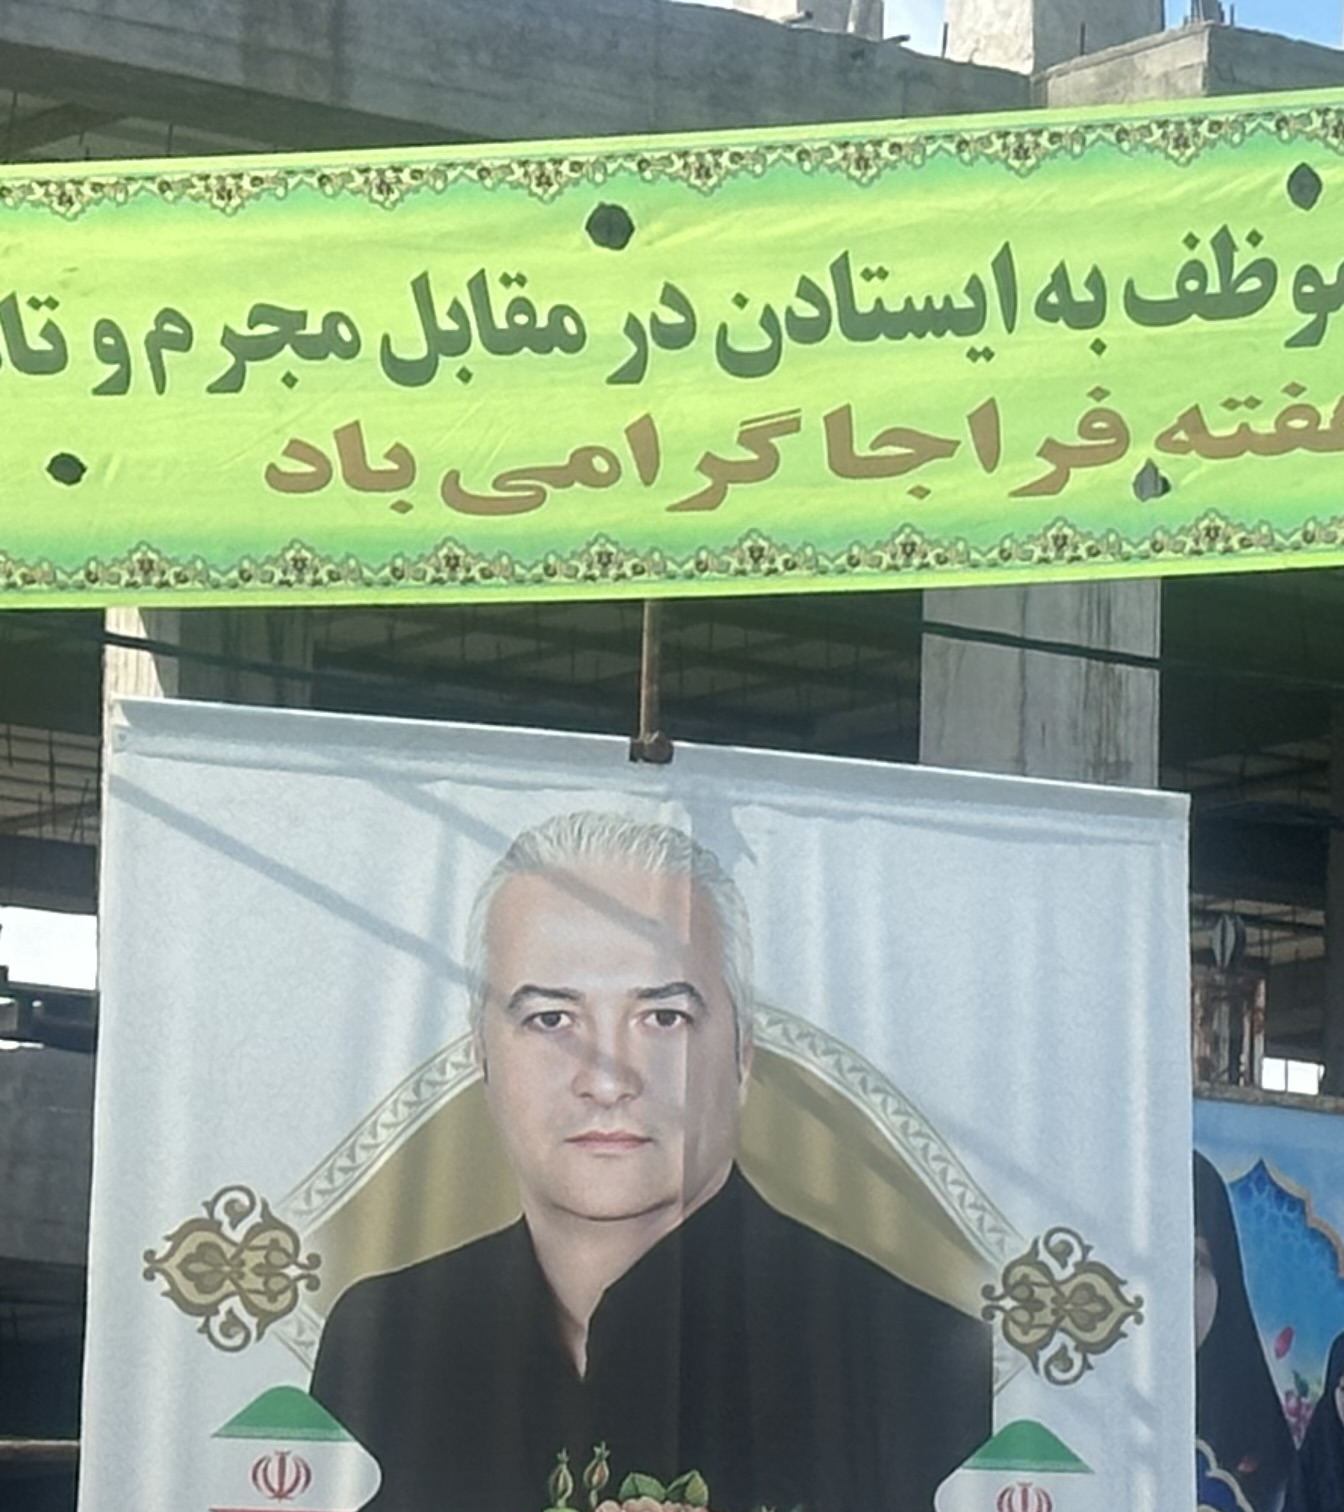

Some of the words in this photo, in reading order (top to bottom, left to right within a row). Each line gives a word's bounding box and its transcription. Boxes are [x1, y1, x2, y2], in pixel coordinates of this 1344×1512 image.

[91, 317, 132, 396] و
[147, 296, 361, 396] مجرم
[380, 268, 586, 388] مقابل
[606, 281, 697, 385] در
[716, 241, 1017, 379] ایستادن
[1034, 257, 1107, 356] به
[264, 420, 417, 515] باد
[439, 408, 803, 516] گرامی
[824, 386, 1132, 500] فراجا
